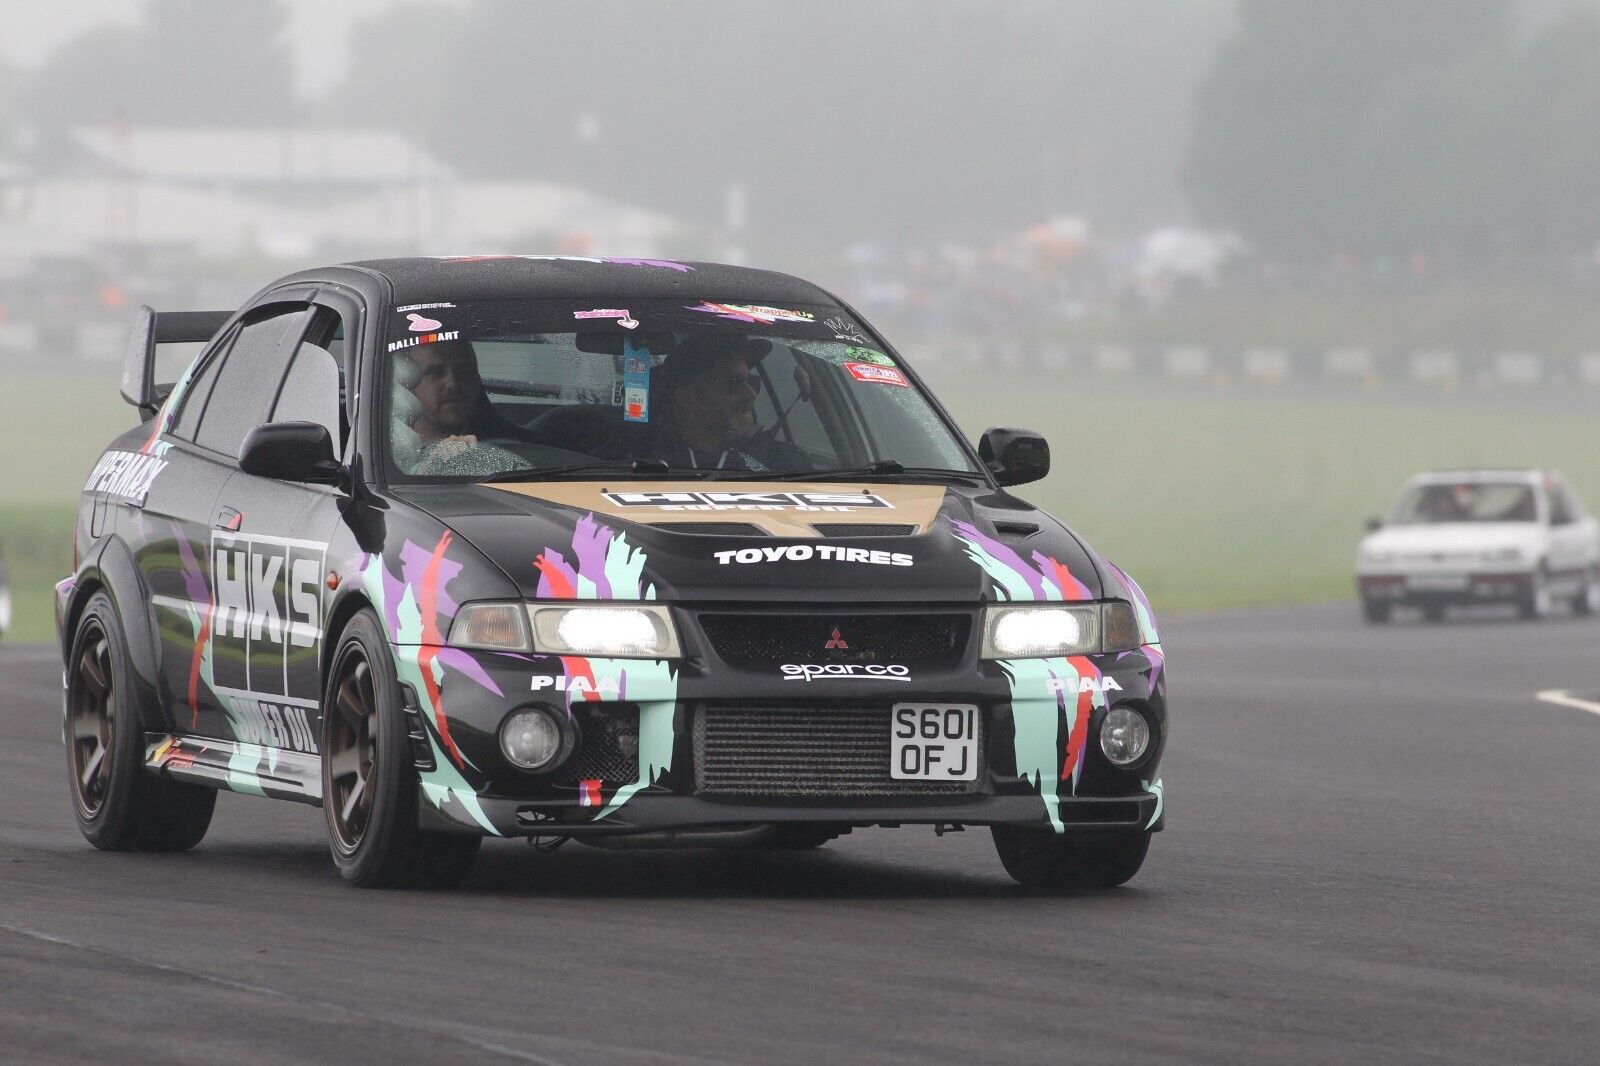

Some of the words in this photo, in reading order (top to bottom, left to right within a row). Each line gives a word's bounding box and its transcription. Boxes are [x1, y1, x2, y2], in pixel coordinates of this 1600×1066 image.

[612, 492, 877, 505] HKS
[714, 545, 814, 565] TOYO
[816, 545, 914, 567] TIRES
[215, 549, 320, 648] HKS
[530, 675, 621, 693] PIAA
[780, 664, 910, 682] sparco
[1045, 676, 1124, 695] PIAA
[284, 706, 319, 754] OIL
[895, 708, 974, 740] S601
[900, 744, 968, 776] OFJ
